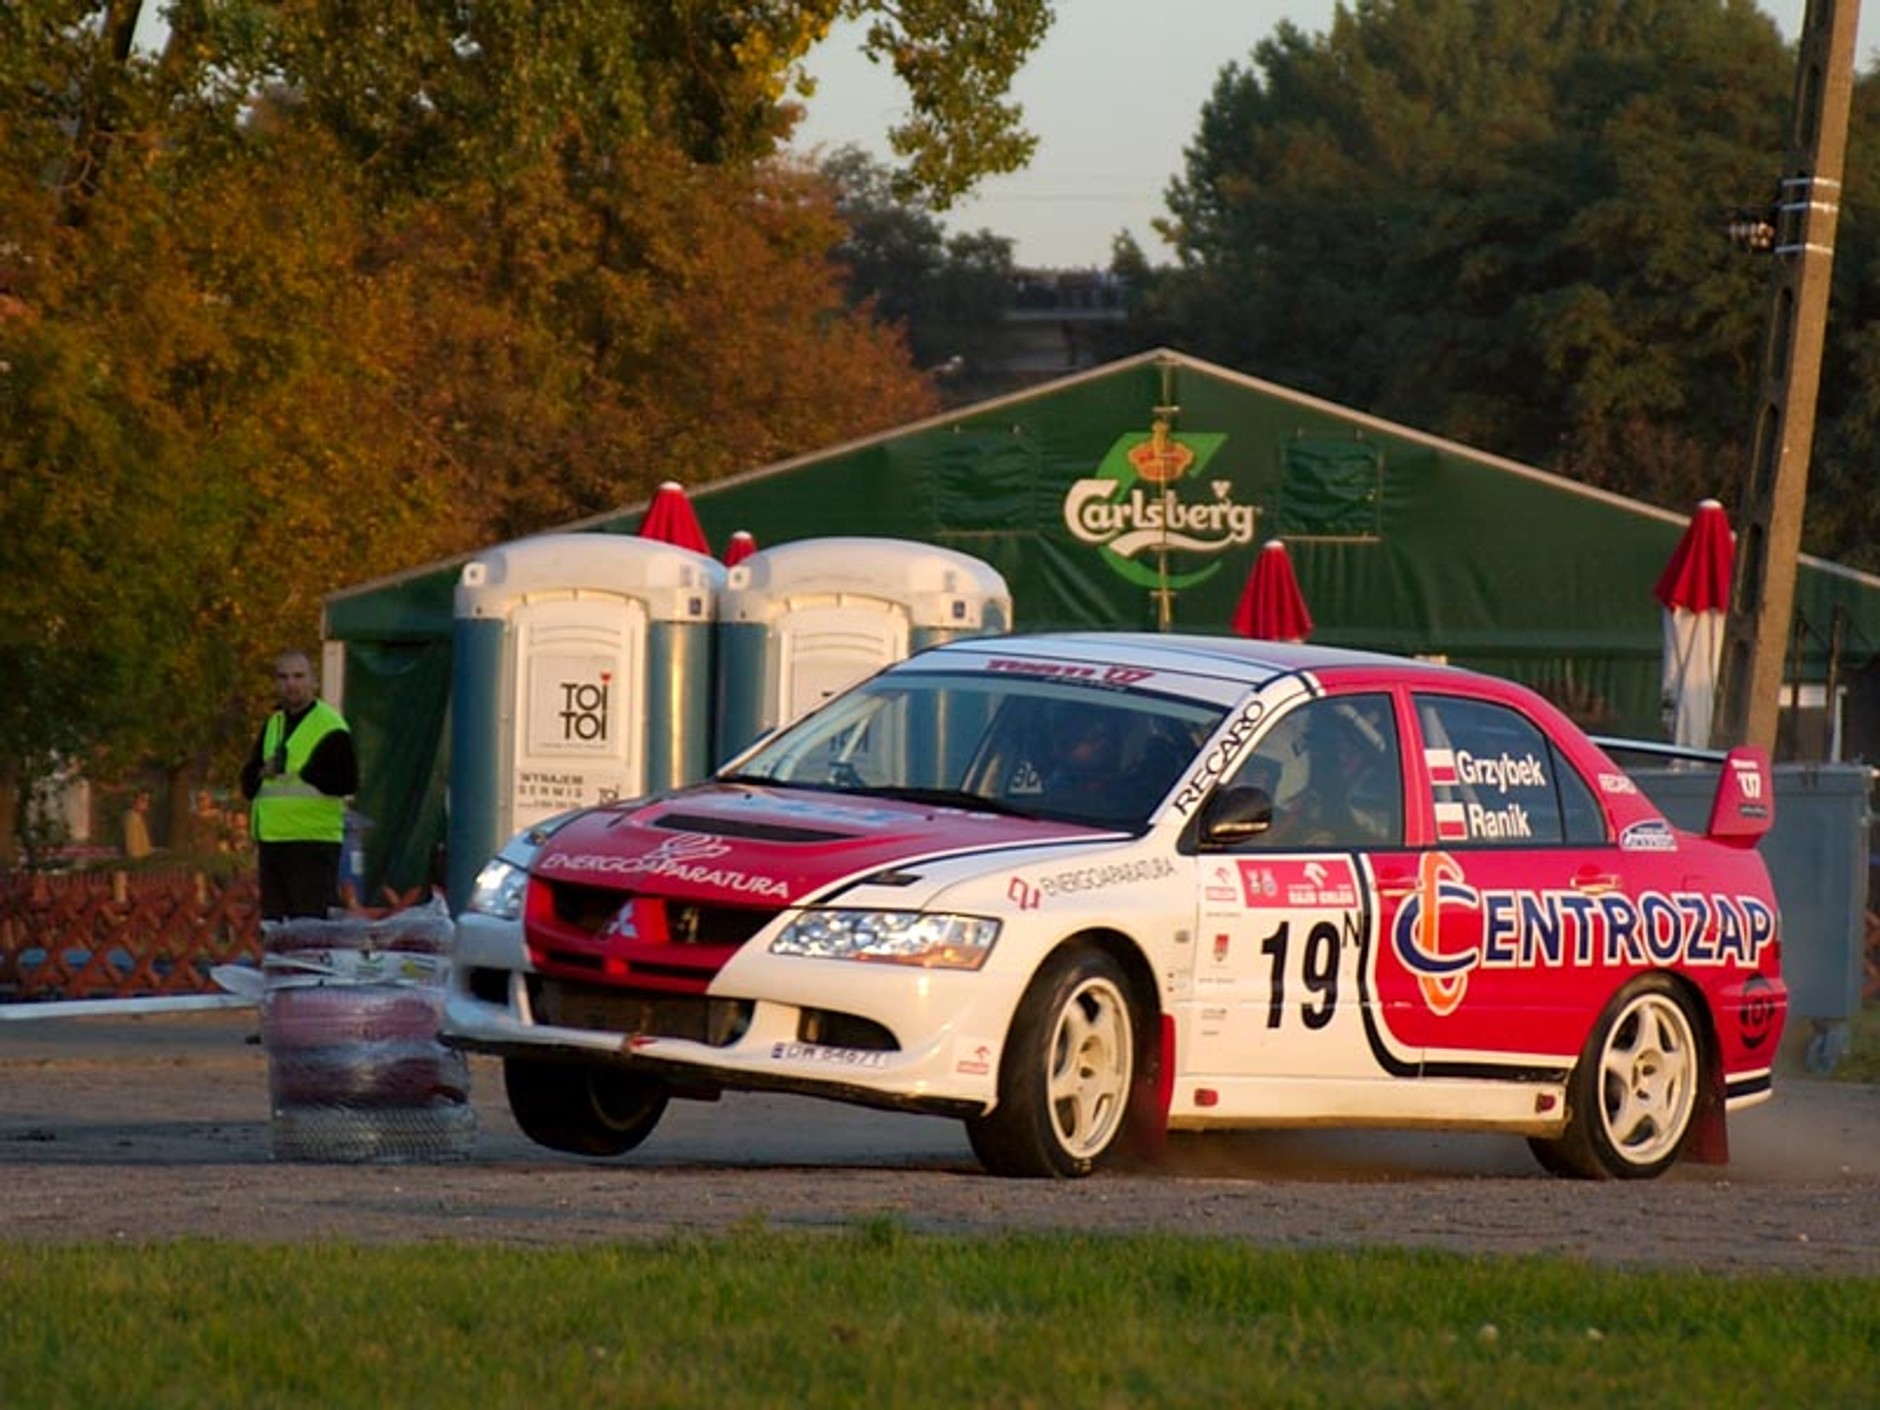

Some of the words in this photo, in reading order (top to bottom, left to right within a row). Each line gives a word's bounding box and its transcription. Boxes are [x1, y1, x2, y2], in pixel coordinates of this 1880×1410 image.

[1064, 479, 1254, 556] Carlsberg
[559, 711, 607, 740] TOI
[1173, 700, 1265, 815] RECARO
[1457, 750, 1546, 793] Grzybek
[1468, 803, 1531, 838] Ranik
[541, 853, 789, 899] ENERGOAPARATURA
[1040, 858, 1176, 896] ENERGOAPARATURA
[1391, 878, 1776, 977] CENTROZAP
[1261, 921, 1341, 1030] 19
[1342, 911, 1362, 948] N
